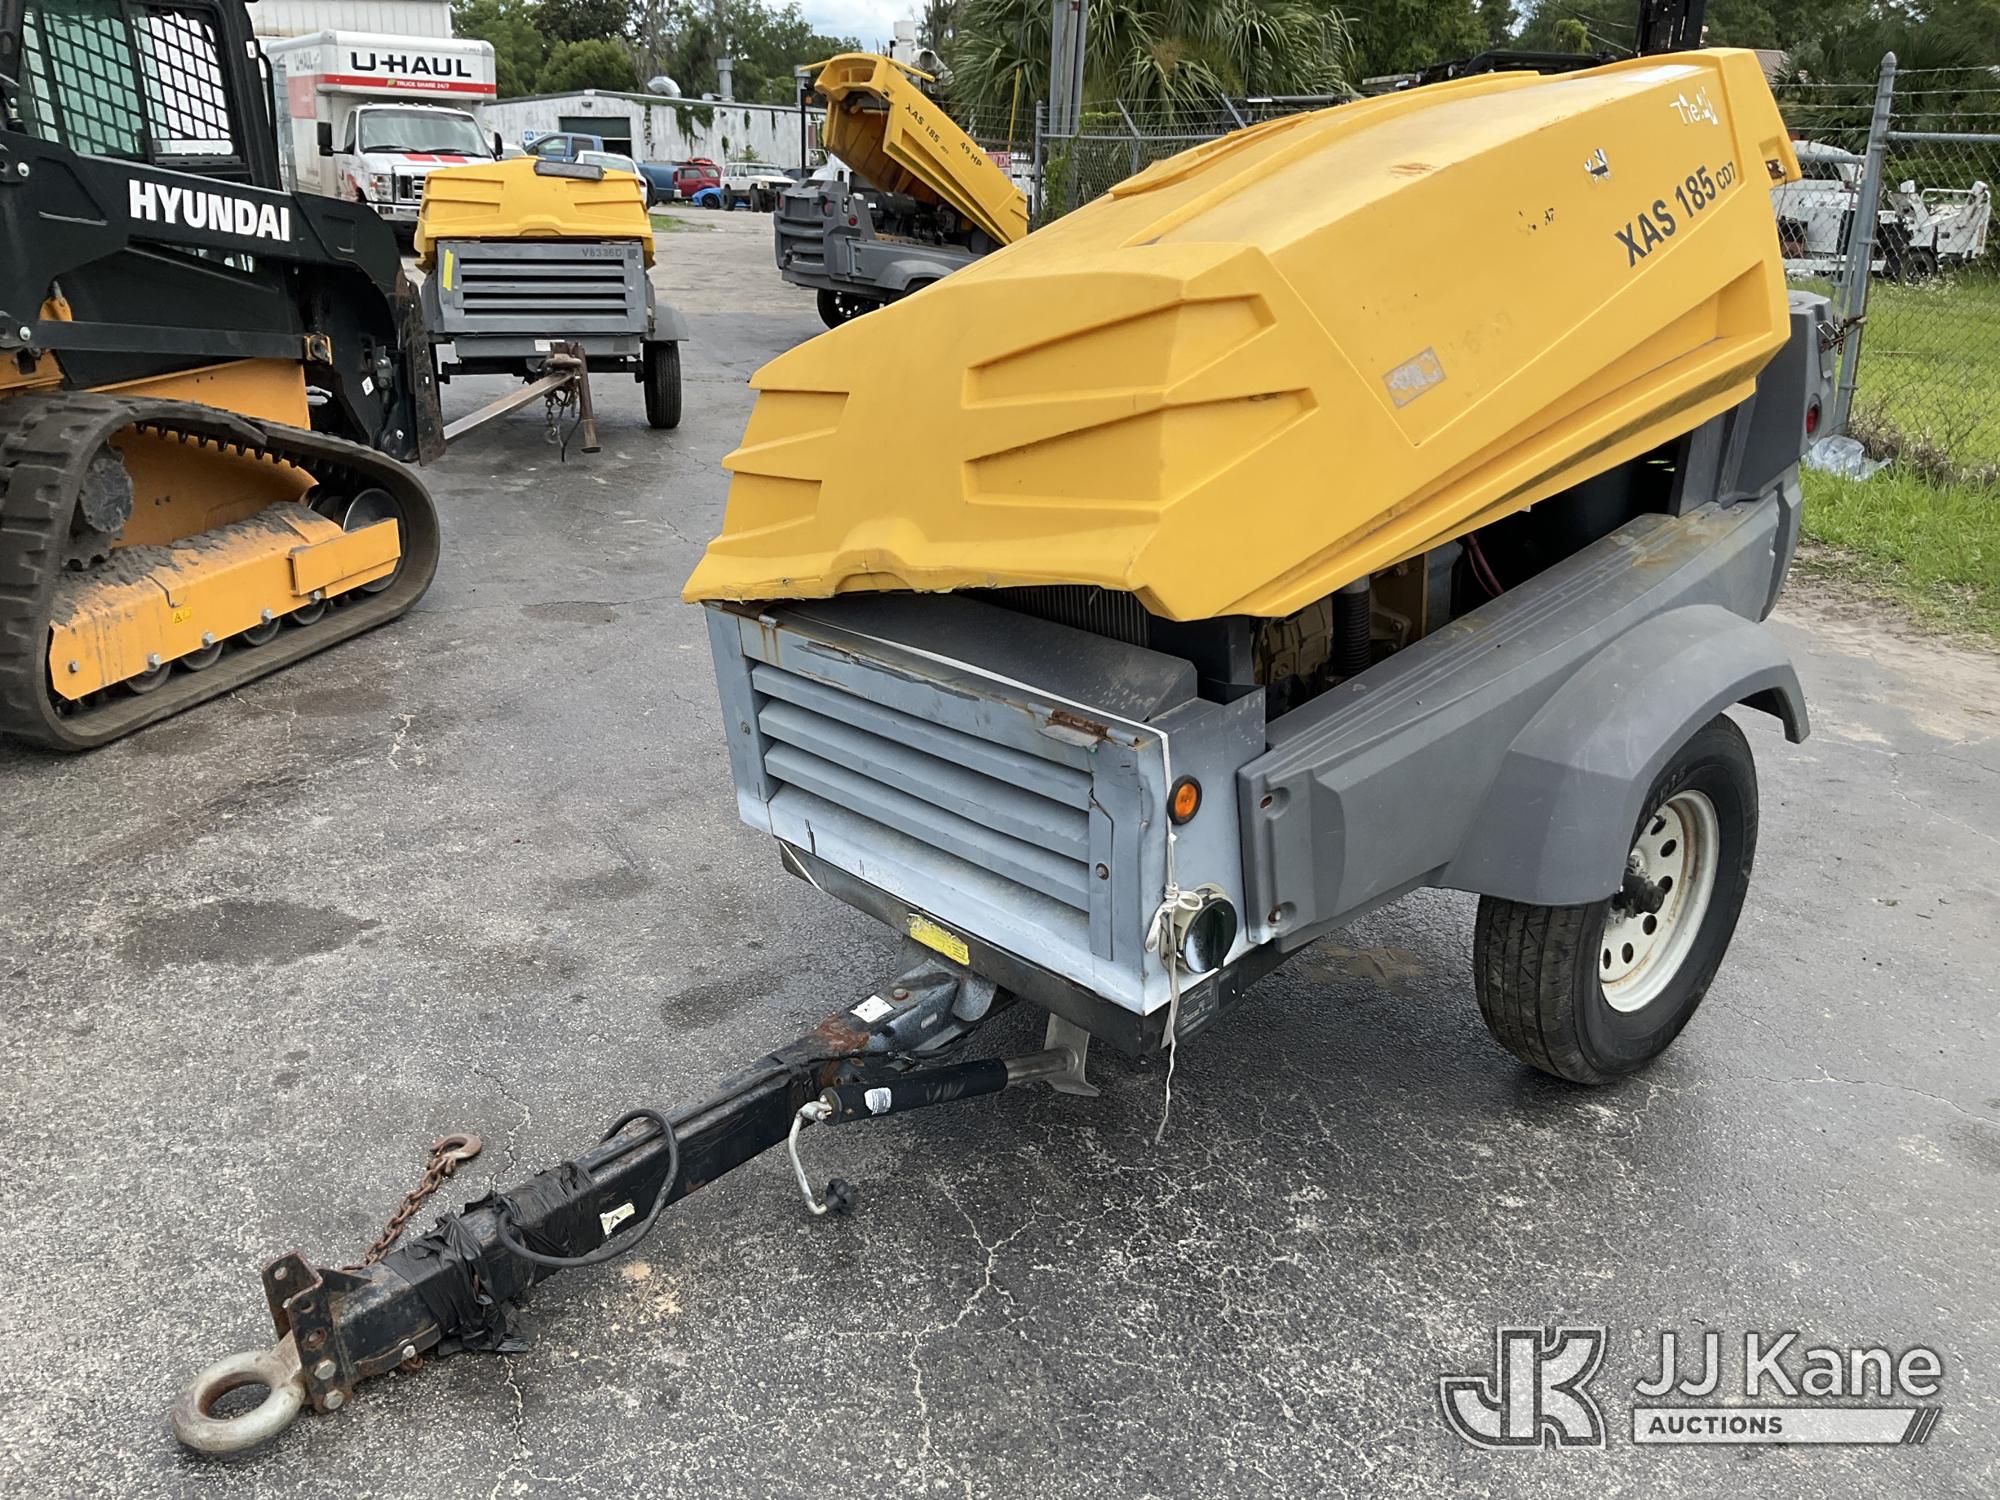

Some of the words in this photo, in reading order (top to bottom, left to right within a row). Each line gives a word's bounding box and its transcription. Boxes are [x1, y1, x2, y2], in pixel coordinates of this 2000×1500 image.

[351, 52, 472, 78] U-HAUL
[926, 126, 940, 143] 185
[960, 142, 971, 154] 49
[971, 154, 983, 167] HP
[129, 179, 291, 242] HYUNDAI
[1614, 199, 1676, 268] XAS
[1675, 165, 1716, 218] 185
[1716, 160, 1737, 190] CD7
